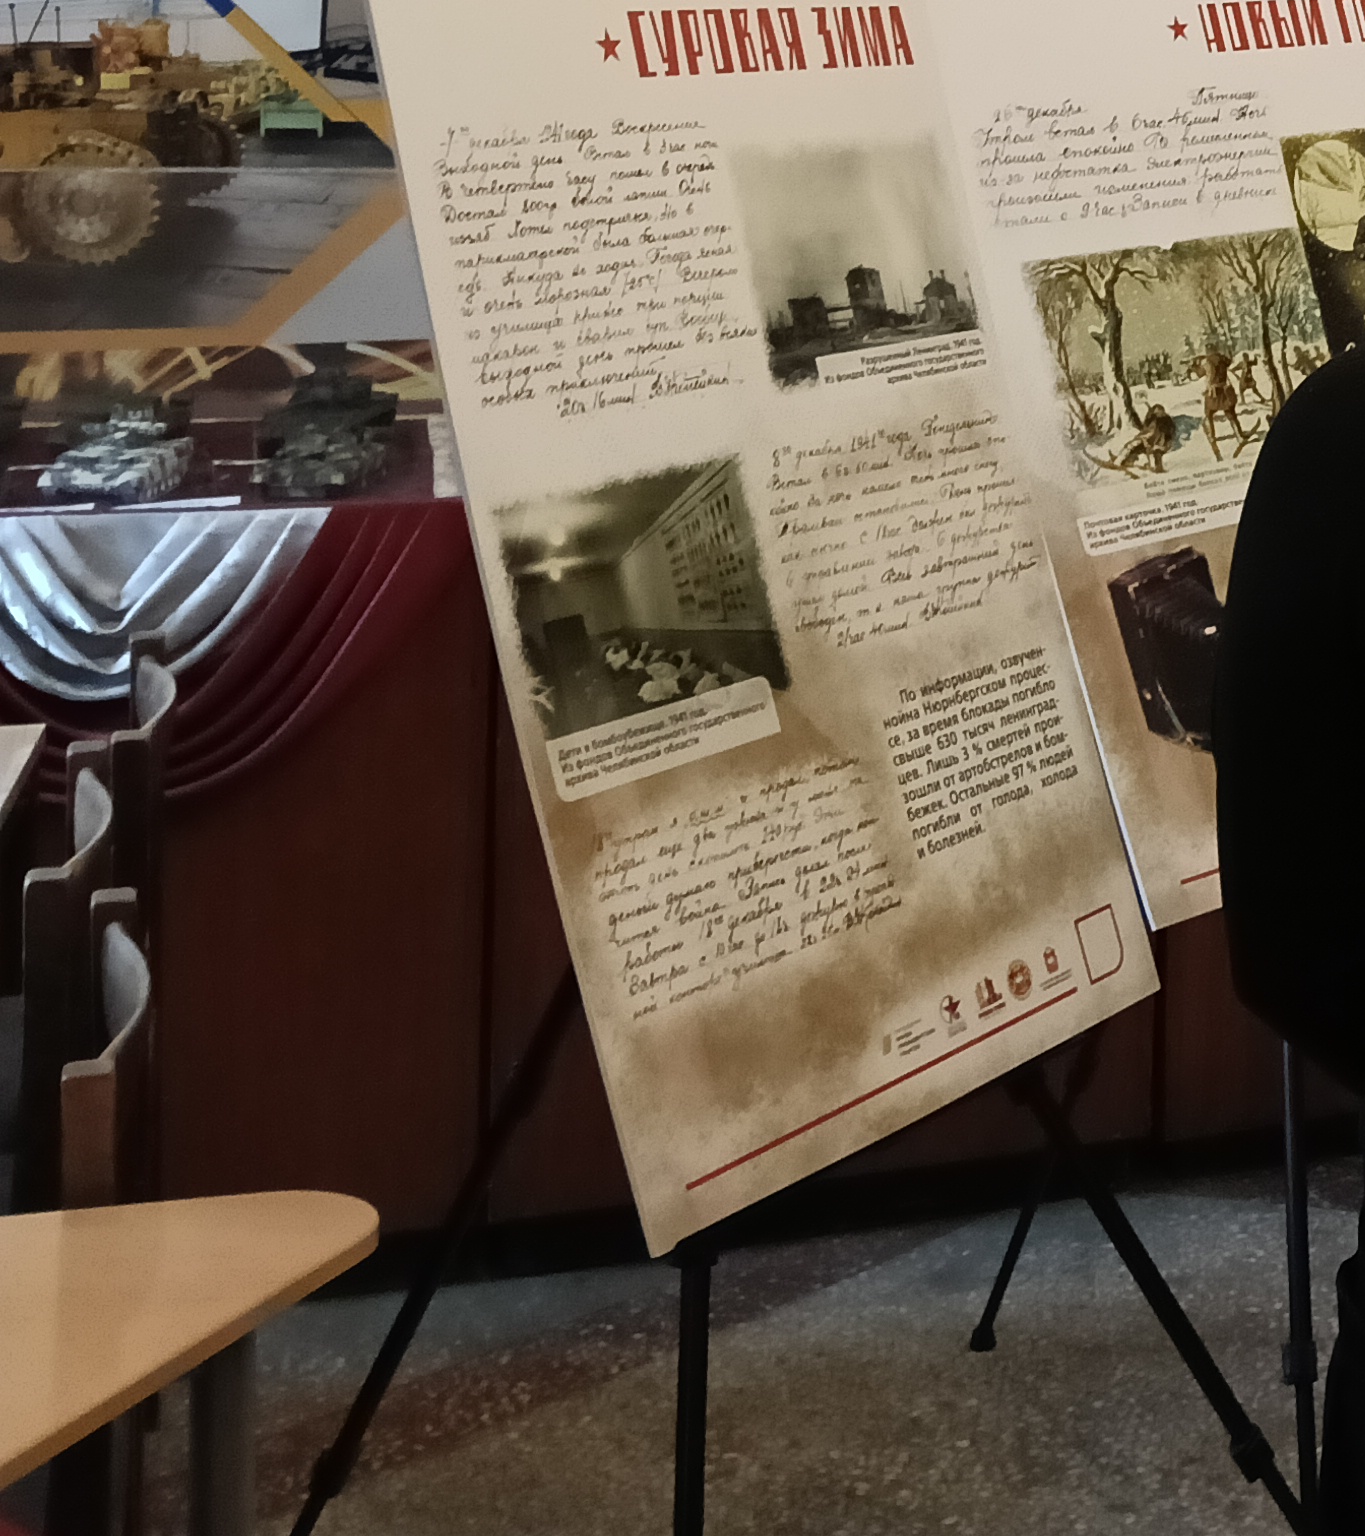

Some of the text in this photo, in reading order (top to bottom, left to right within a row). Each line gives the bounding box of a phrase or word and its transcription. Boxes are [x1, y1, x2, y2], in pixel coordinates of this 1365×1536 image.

[626, 5, 914, 77] СУРОВАЯ ЗИМА
[882, 708, 920, 729] нойна
[921, 677, 1006, 715] Нюрнбергском
[898, 688, 916, 703] По
[906, 728, 920, 742] за
[921, 713, 959, 736] время
[960, 696, 1010, 722] блокады
[1011, 679, 1055, 703] погибло
[892, 743, 932, 766] свыше
[936, 730, 957, 750] 630
[961, 720, 995, 740] тысяч
[896, 768, 923, 785] цев.
[925, 755, 959, 774] Лишь
[960, 745, 969, 761] 3
[971, 742, 983, 755] %
[985, 722, 1031, 751] смертей
[901, 779, 941, 804] зошли
[942, 773, 955, 788] от
[958, 744, 1033, 782] артобстрелов
[1034, 740, 1042, 752] и
[906, 744, 1073, 822] бежек. Остальные 97 % людей
[911, 812, 961, 841] погибли
[969, 802, 982, 817] от
[1040, 764, 1078, 787] холода
[916, 820, 985, 859] и болезней.
